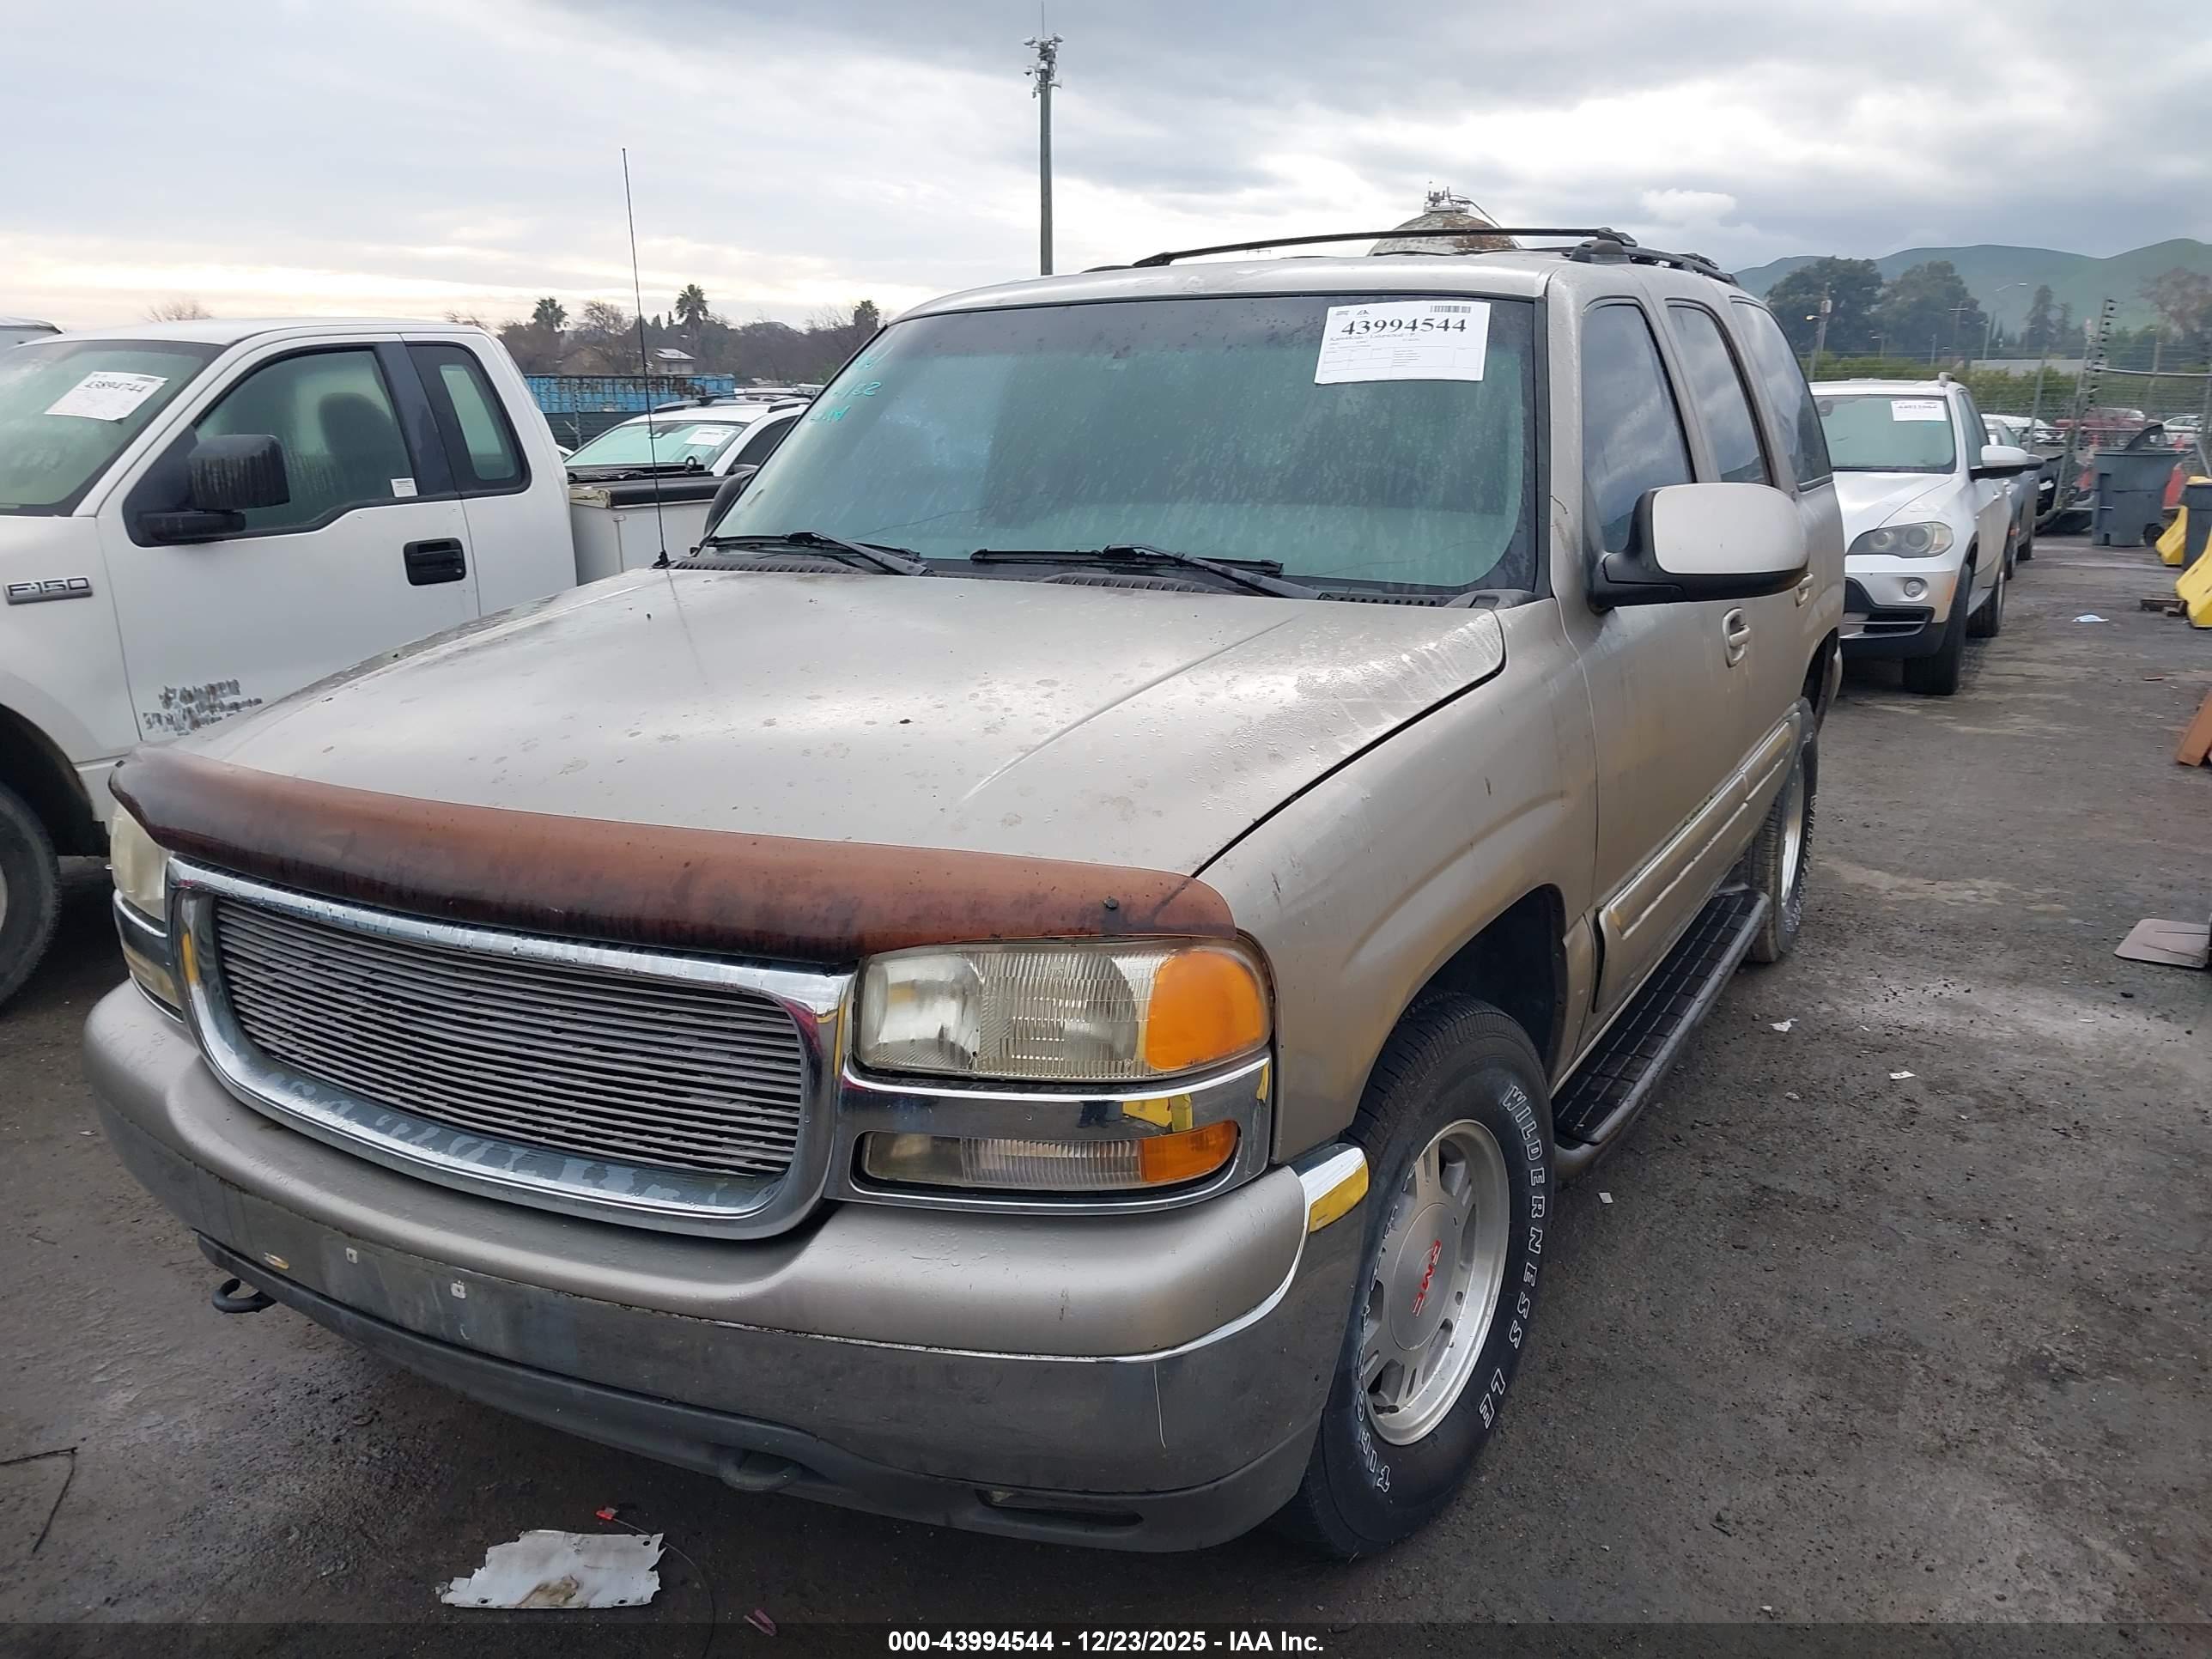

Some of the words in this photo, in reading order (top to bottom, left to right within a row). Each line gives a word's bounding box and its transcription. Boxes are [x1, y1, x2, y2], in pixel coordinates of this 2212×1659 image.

[1340, 318, 1468, 335] 43994544
[7, 577, 90, 597] F-150
[1500, 1084, 1546, 1350] WILDERNESS
[1413, 1239, 1442, 1317] GMC
[1479, 1367, 1506, 1430] LE
